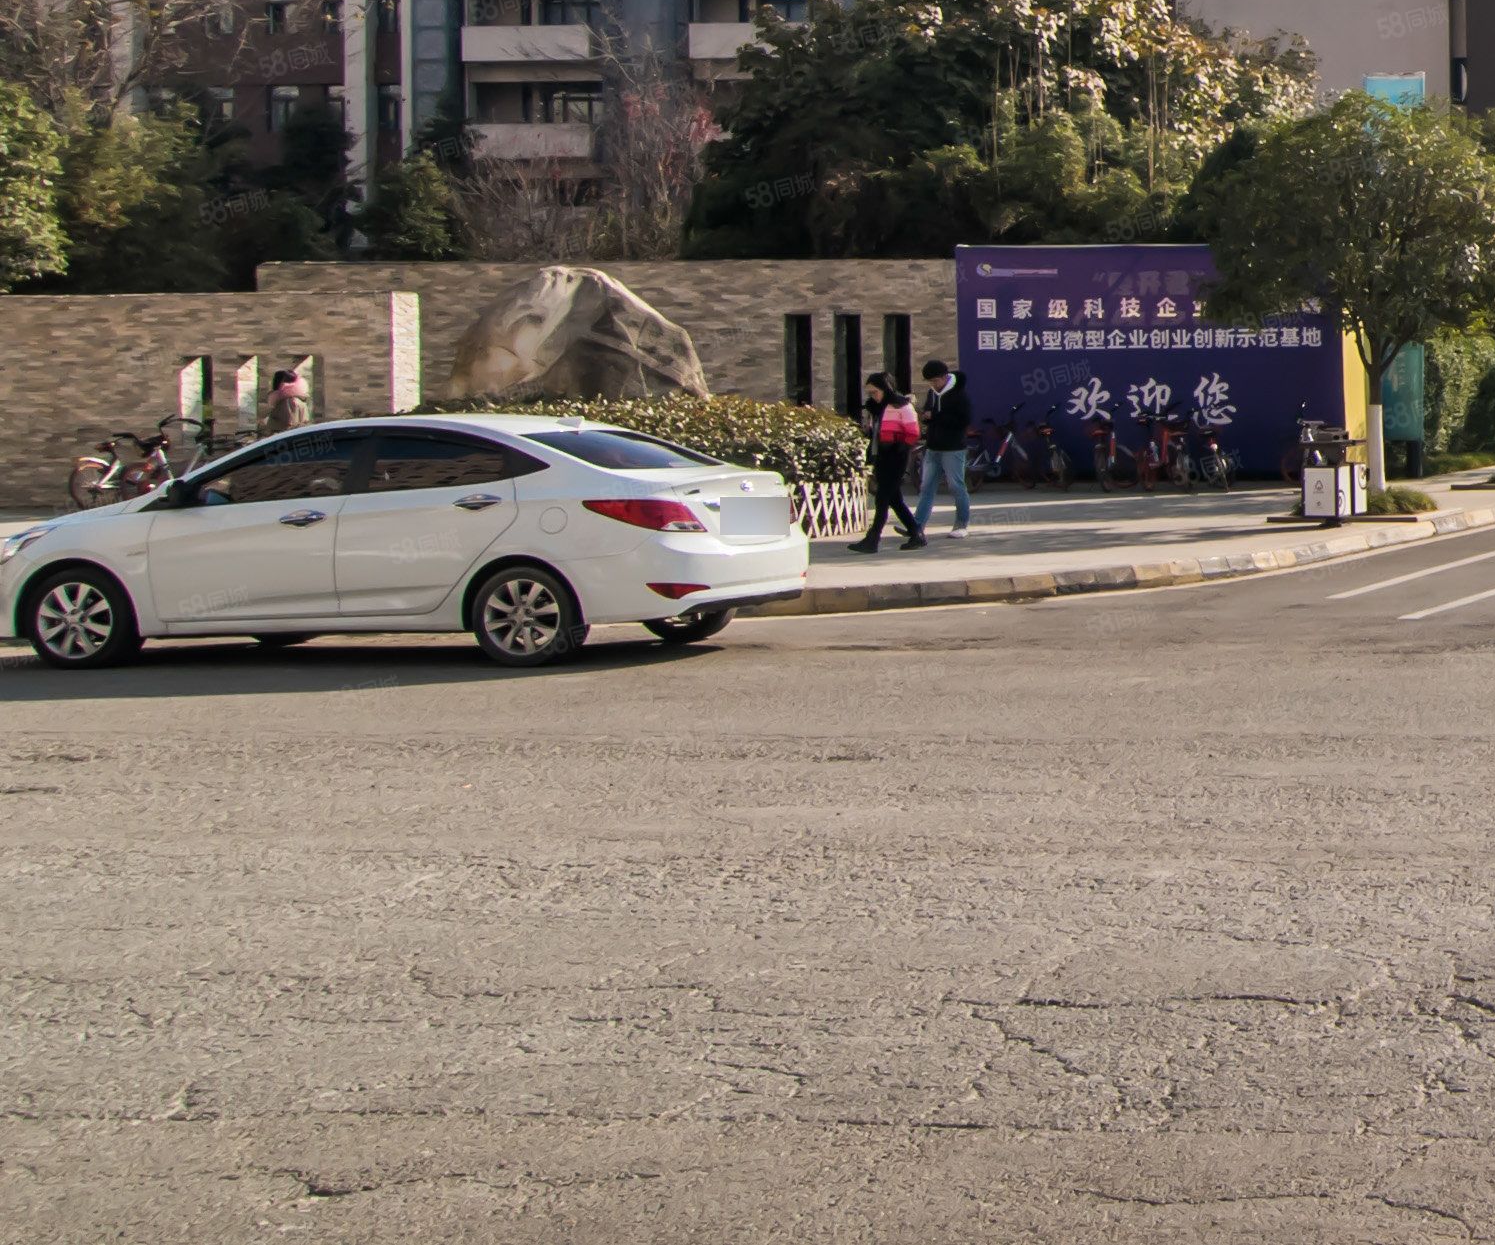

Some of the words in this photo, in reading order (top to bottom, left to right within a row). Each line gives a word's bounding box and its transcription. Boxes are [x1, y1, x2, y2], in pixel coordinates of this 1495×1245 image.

[977, 328, 1322, 351] 国家小型微型企业创业创新示范基地
[1066, 372, 1238, 429] 欢迎您
